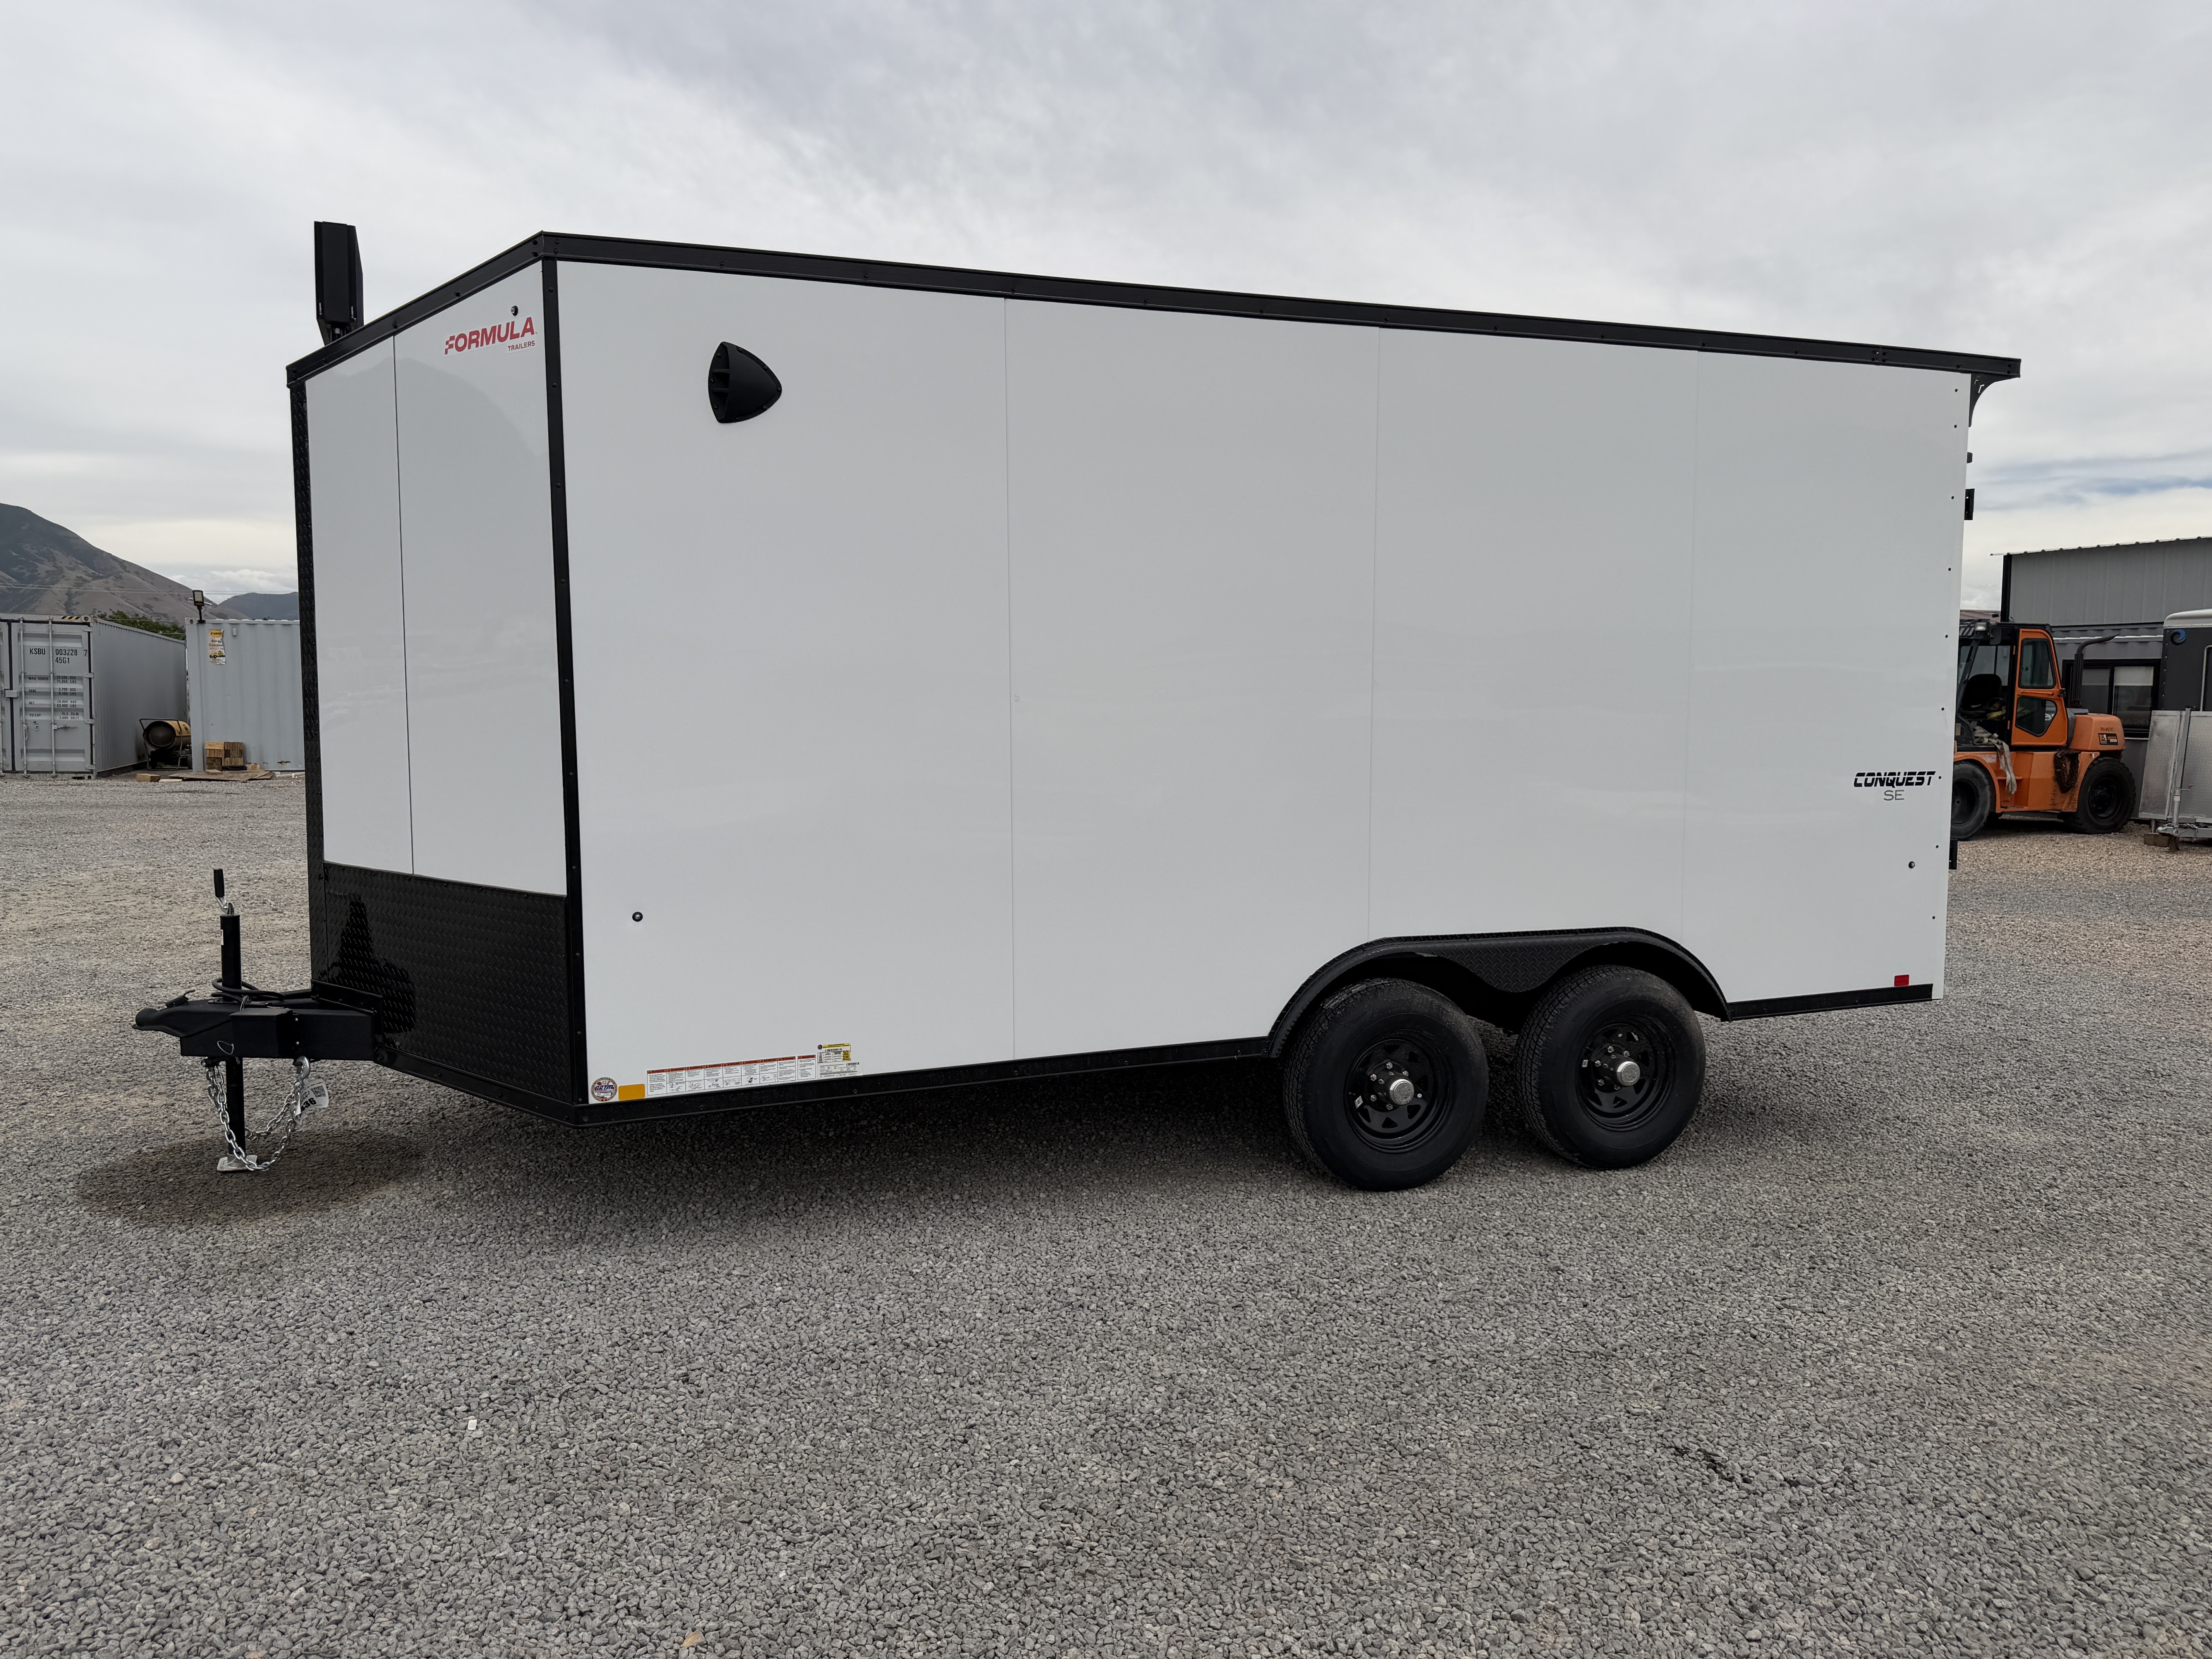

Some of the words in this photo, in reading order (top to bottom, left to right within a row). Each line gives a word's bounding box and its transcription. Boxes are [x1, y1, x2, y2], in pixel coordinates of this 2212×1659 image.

[445, 317, 535, 355] FORMULA
[508, 340, 535, 351] TRAILERS
[1853, 771, 1936, 788] CONQUEST
[1884, 790, 1905, 801] SE
